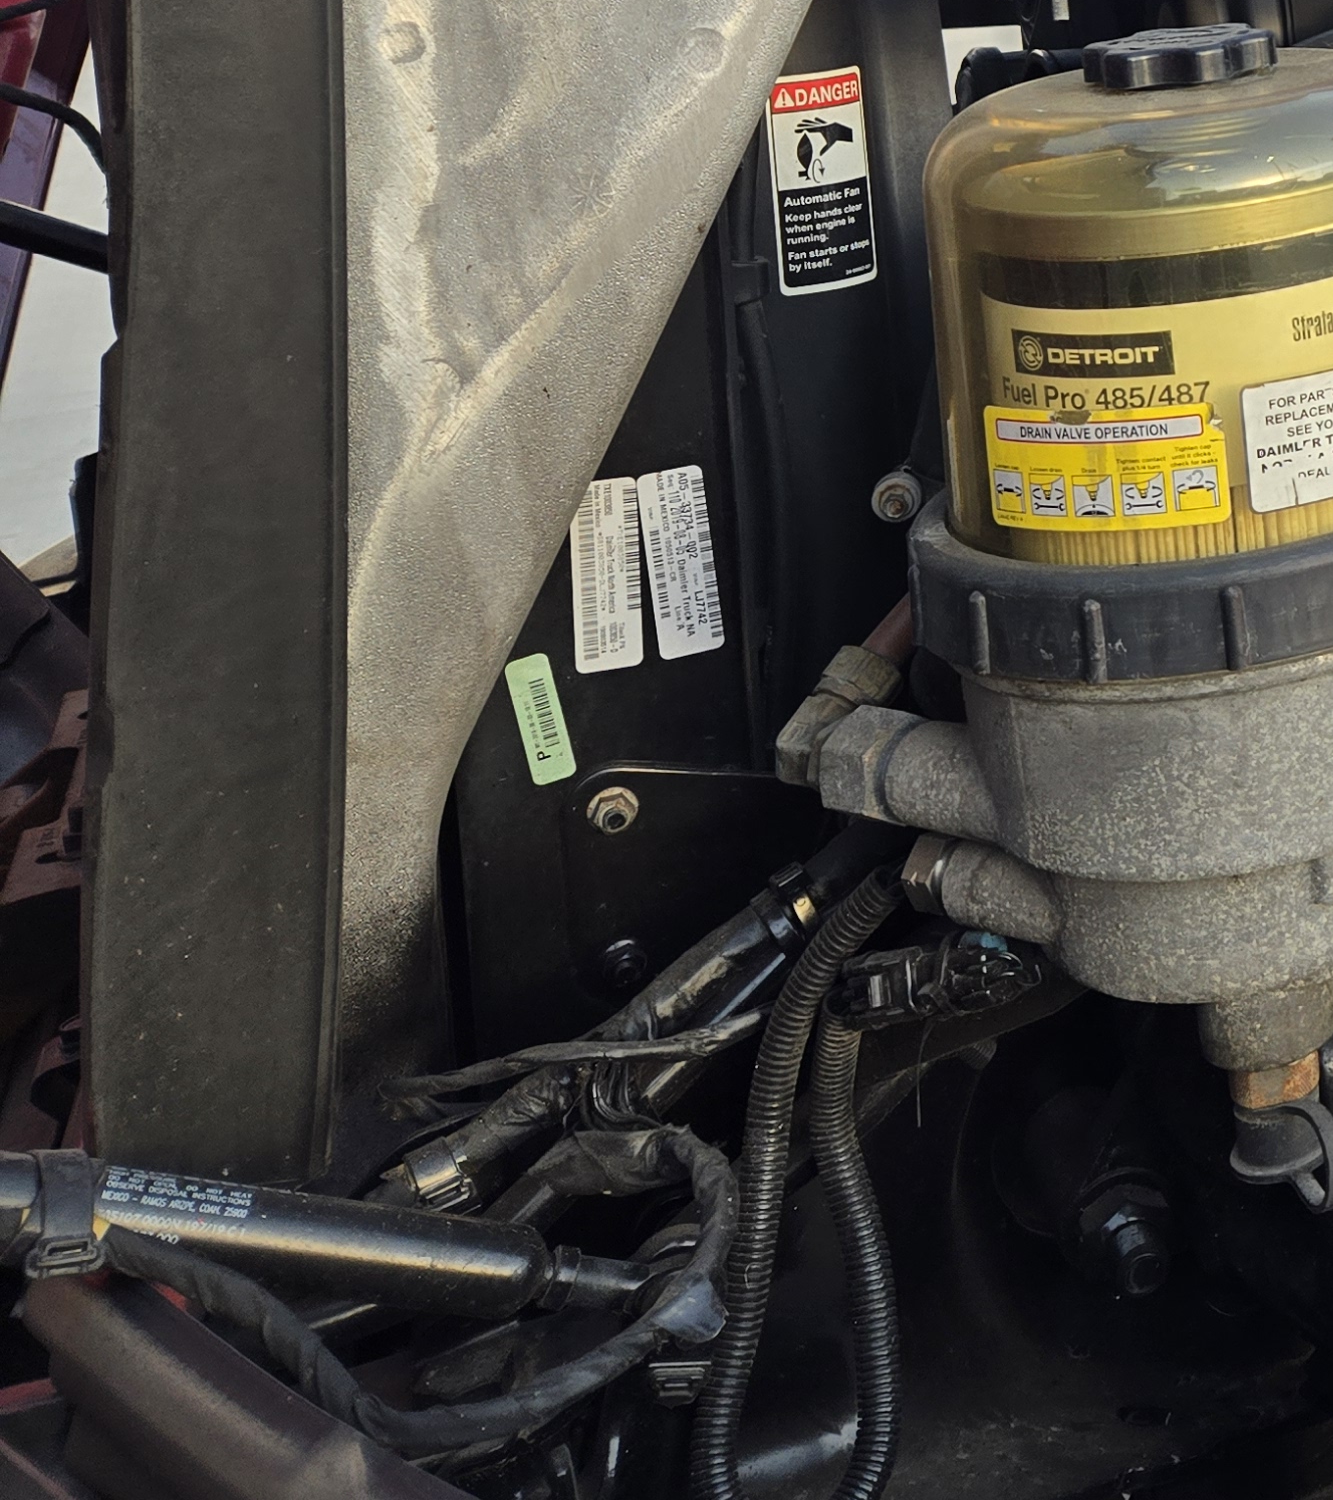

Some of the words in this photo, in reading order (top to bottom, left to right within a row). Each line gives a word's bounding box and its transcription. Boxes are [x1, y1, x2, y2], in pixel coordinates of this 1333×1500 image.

[794, 80, 858, 106] DANGER
[784, 189, 843, 208] Automatic
[843, 186, 860, 199] Fan
[785, 211, 812, 224] Keep
[813, 207, 842, 220] hands
[843, 202, 863, 214] clear
[786, 223, 814, 234] when
[815, 218, 847, 232] engine
[848, 215, 856, 225] is
[787, 233, 829, 247] running.
[788, 250, 807, 261] Fan
[808, 245, 838, 259] starts
[839, 243, 849, 254] or
[850, 238, 870, 252] stops
[789, 261, 802, 273] by
[803, 257, 833, 270] itself.
[1046, 346, 1160, 365] DETROIT
[1002, 376, 1036, 406] Fuel
[1044, 384, 1086, 410] Pro
[1095, 381, 1211, 410] 485/487
[1268, 395, 1297, 410] FOR
[1020, 425, 1052, 439] DRAIN
[1054, 426, 1091, 439] VALVE
[1094, 423, 1169, 439] OPERATION
[1286, 423, 1313, 437] SEE
[1174, 446, 1198, 454] Tighten
[1199, 444, 1212, 452] cap
[1193, 451, 1212, 459] clicks
[1191, 458, 1201, 466] for
[1201, 457, 1219, 465] leaks
[660, 503, 671, 533] MEXICO
[677, 558, 689, 594] Daimler
[685, 595, 694, 625] Truck
[694, 590, 709, 627] LJ7742
[687, 625, 697, 637] NA
[537, 751, 552, 762] P
[106, 1180, 145, 1192] OBSERVE
[148, 1186, 188, 1198] DISPOSAL
[191, 1192, 251, 1207] INSTRUCTIONS
[108, 1174, 121, 1182] DO
[128, 1176, 146, 1185] NOT
[186, 1184, 199, 1192] DO
[205, 1187, 223, 1196] NOT
[229, 1190, 253, 1199] HEAT
[101, 1190, 130, 1203] MEXICO
[140, 1195, 167, 1208] RAMOS
